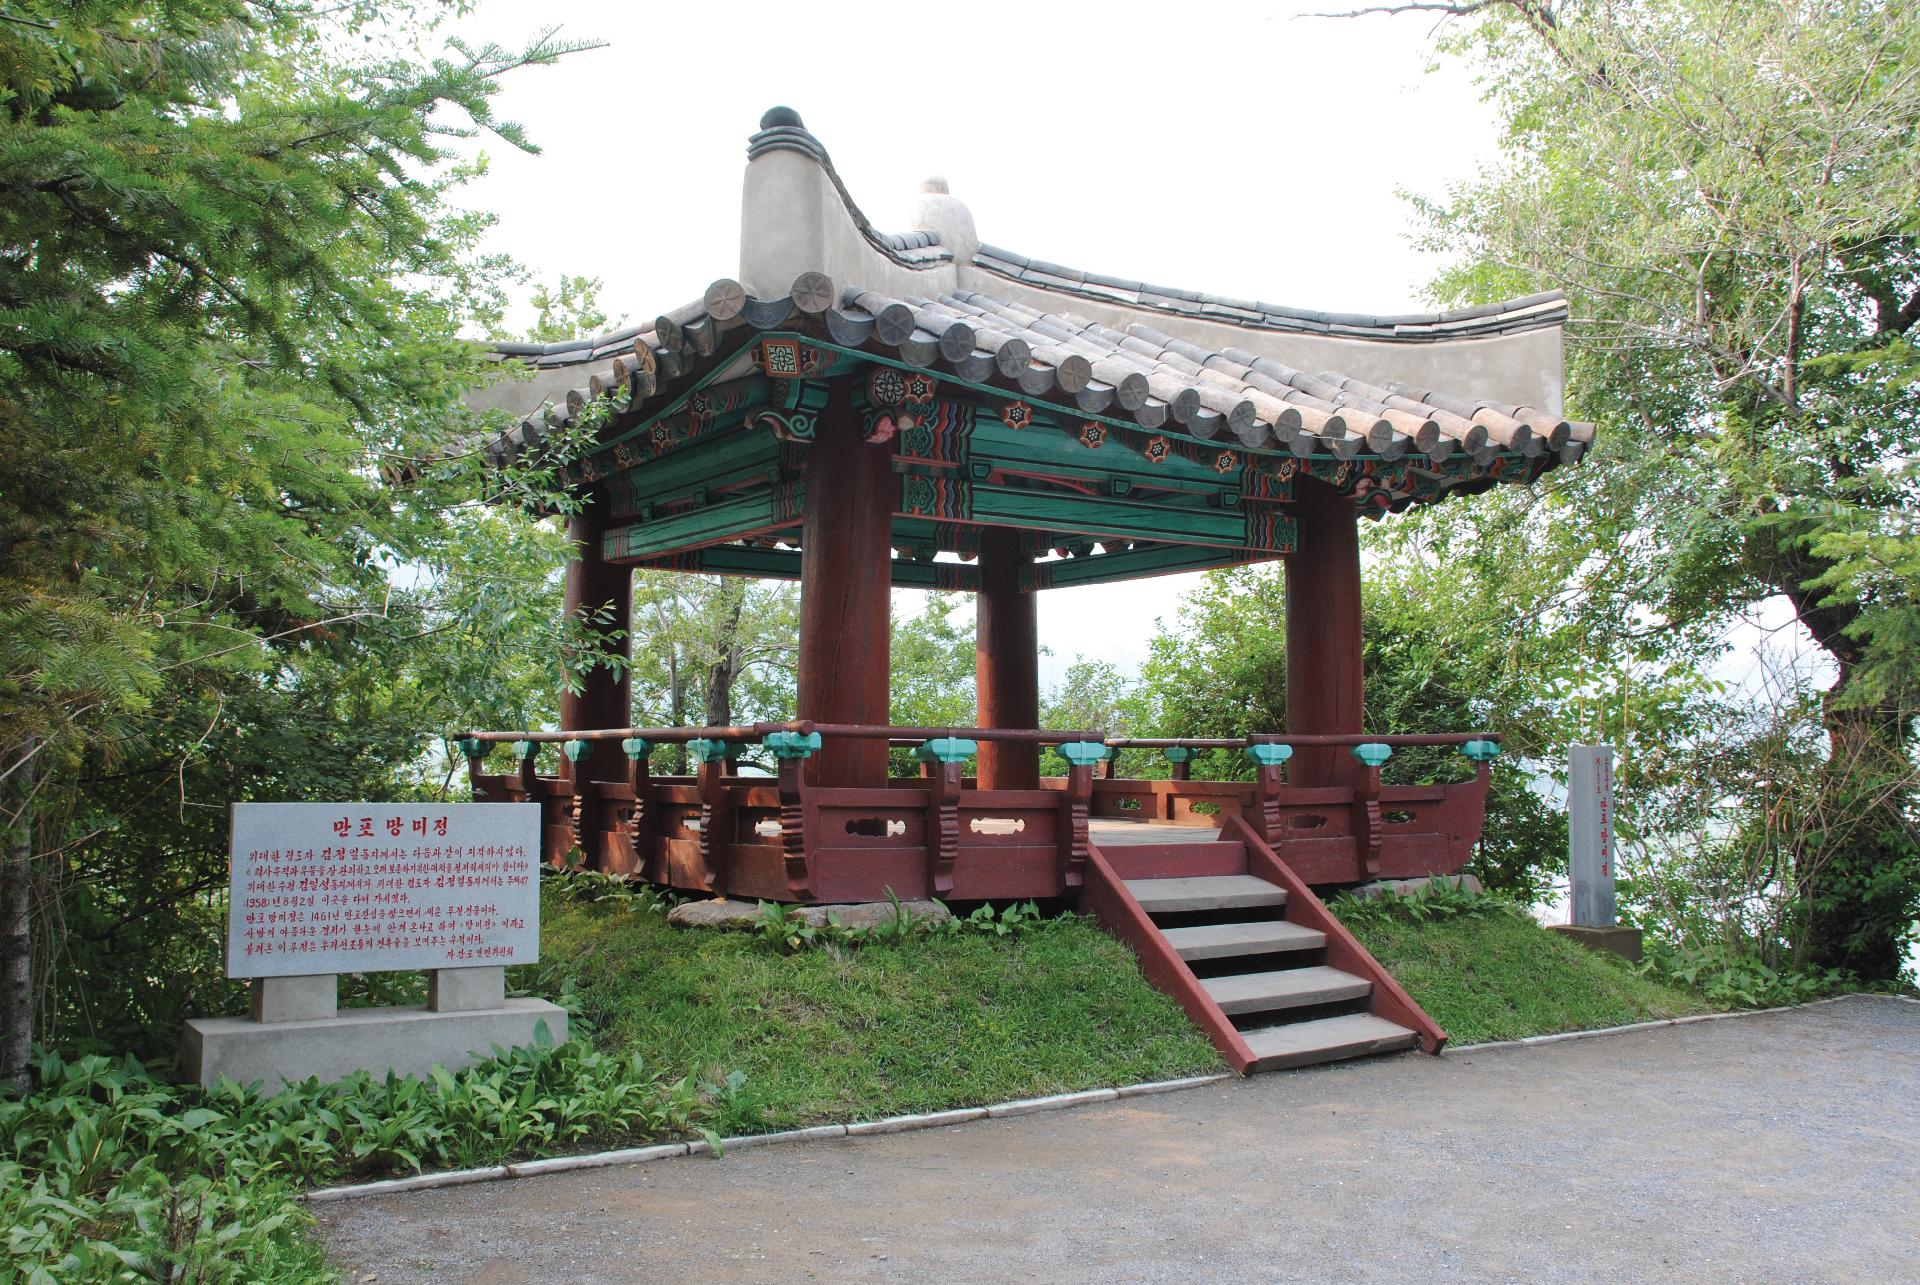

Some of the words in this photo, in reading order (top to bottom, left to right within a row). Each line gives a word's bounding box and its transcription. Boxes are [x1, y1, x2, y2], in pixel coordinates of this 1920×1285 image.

[332, 817, 375, 838] 만포
[384, 817, 448, 837] 망미정
[247, 850, 281, 862] 위대한
[412, 847, 443, 859] 다음과
[442, 846, 463, 858] 같이
[246, 881, 277, 893] 위대한
[376, 878, 404, 889] 위대한
[321, 895, 349, 905] 이곳을
[245, 912, 265, 924] 만포
[310, 910, 340, 921] 1461년
[244, 927, 275, 939] 사방의
[279, 926, 317, 937] 아름다운
[319, 924, 348, 936] 경치가
[352, 924, 381, 934] 한눈에
[412, 936, 446, 946] 보여주는
